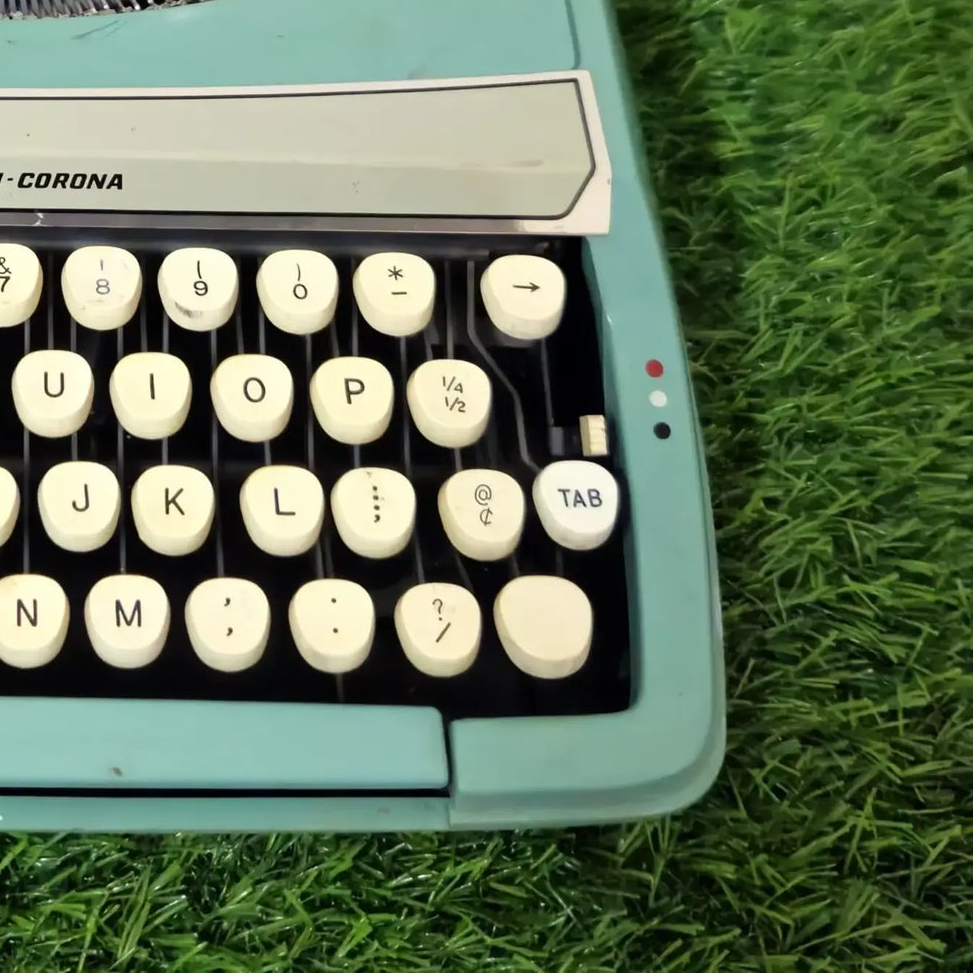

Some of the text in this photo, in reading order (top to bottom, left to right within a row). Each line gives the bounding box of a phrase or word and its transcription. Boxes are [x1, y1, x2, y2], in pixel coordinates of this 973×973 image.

[95, 278, 111, 295] 8
[193, 280, 209, 297] 9
[43, 371, 65, 398] U
[149, 373, 156, 400] I
[243, 377, 266, 403] O
[344, 378, 365, 404] P
[72, 483, 90, 512] J
[165, 488, 185, 516] K
[274, 487, 296, 516] L
[474, 484, 493, 506] @
[557, 488, 603, 509] TAB
[17, 598, 38, 627] N
[115, 599, 142, 628] M
[432, 598, 444, 622] ?
